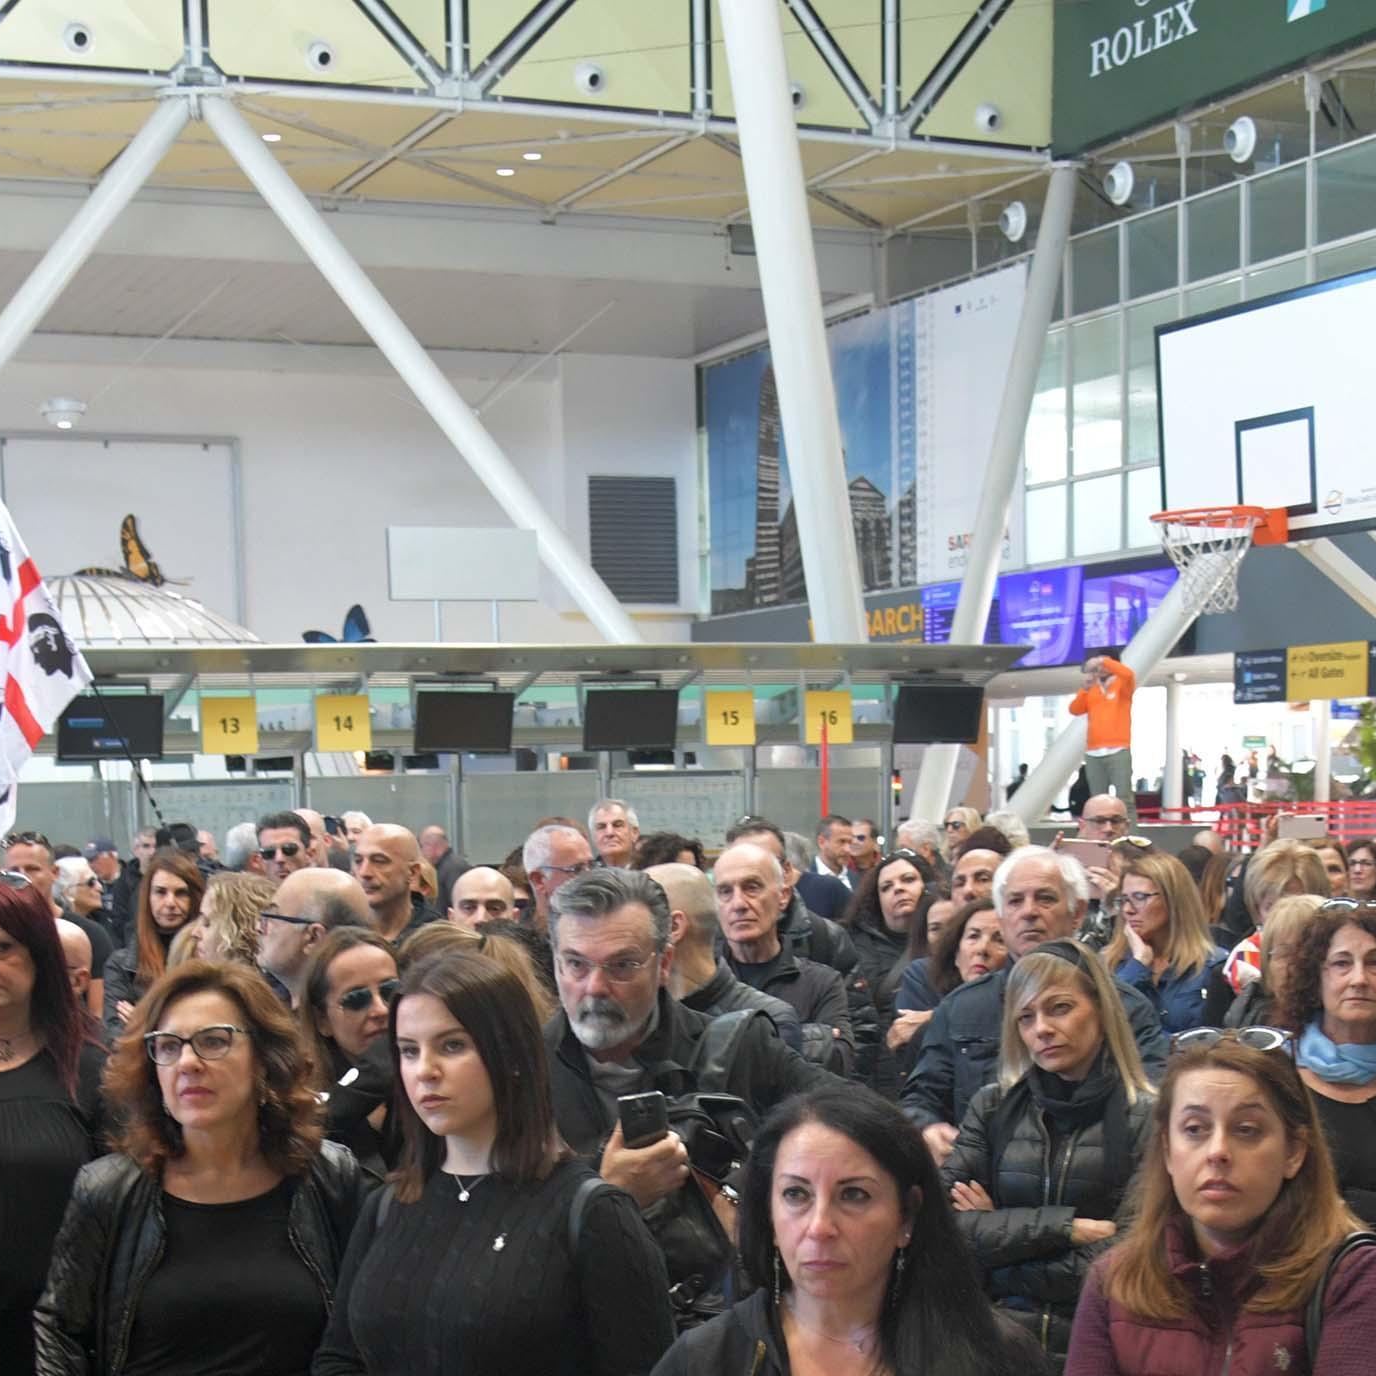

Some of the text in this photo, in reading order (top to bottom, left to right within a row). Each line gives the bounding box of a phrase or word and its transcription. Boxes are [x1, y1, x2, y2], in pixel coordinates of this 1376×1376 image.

[1089, 0, 1198, 77] ROLEX
[219, 717, 240, 734] 13
[332, 715, 353, 732] 14
[721, 710, 740, 726] 15
[819, 710, 838, 726] 16
